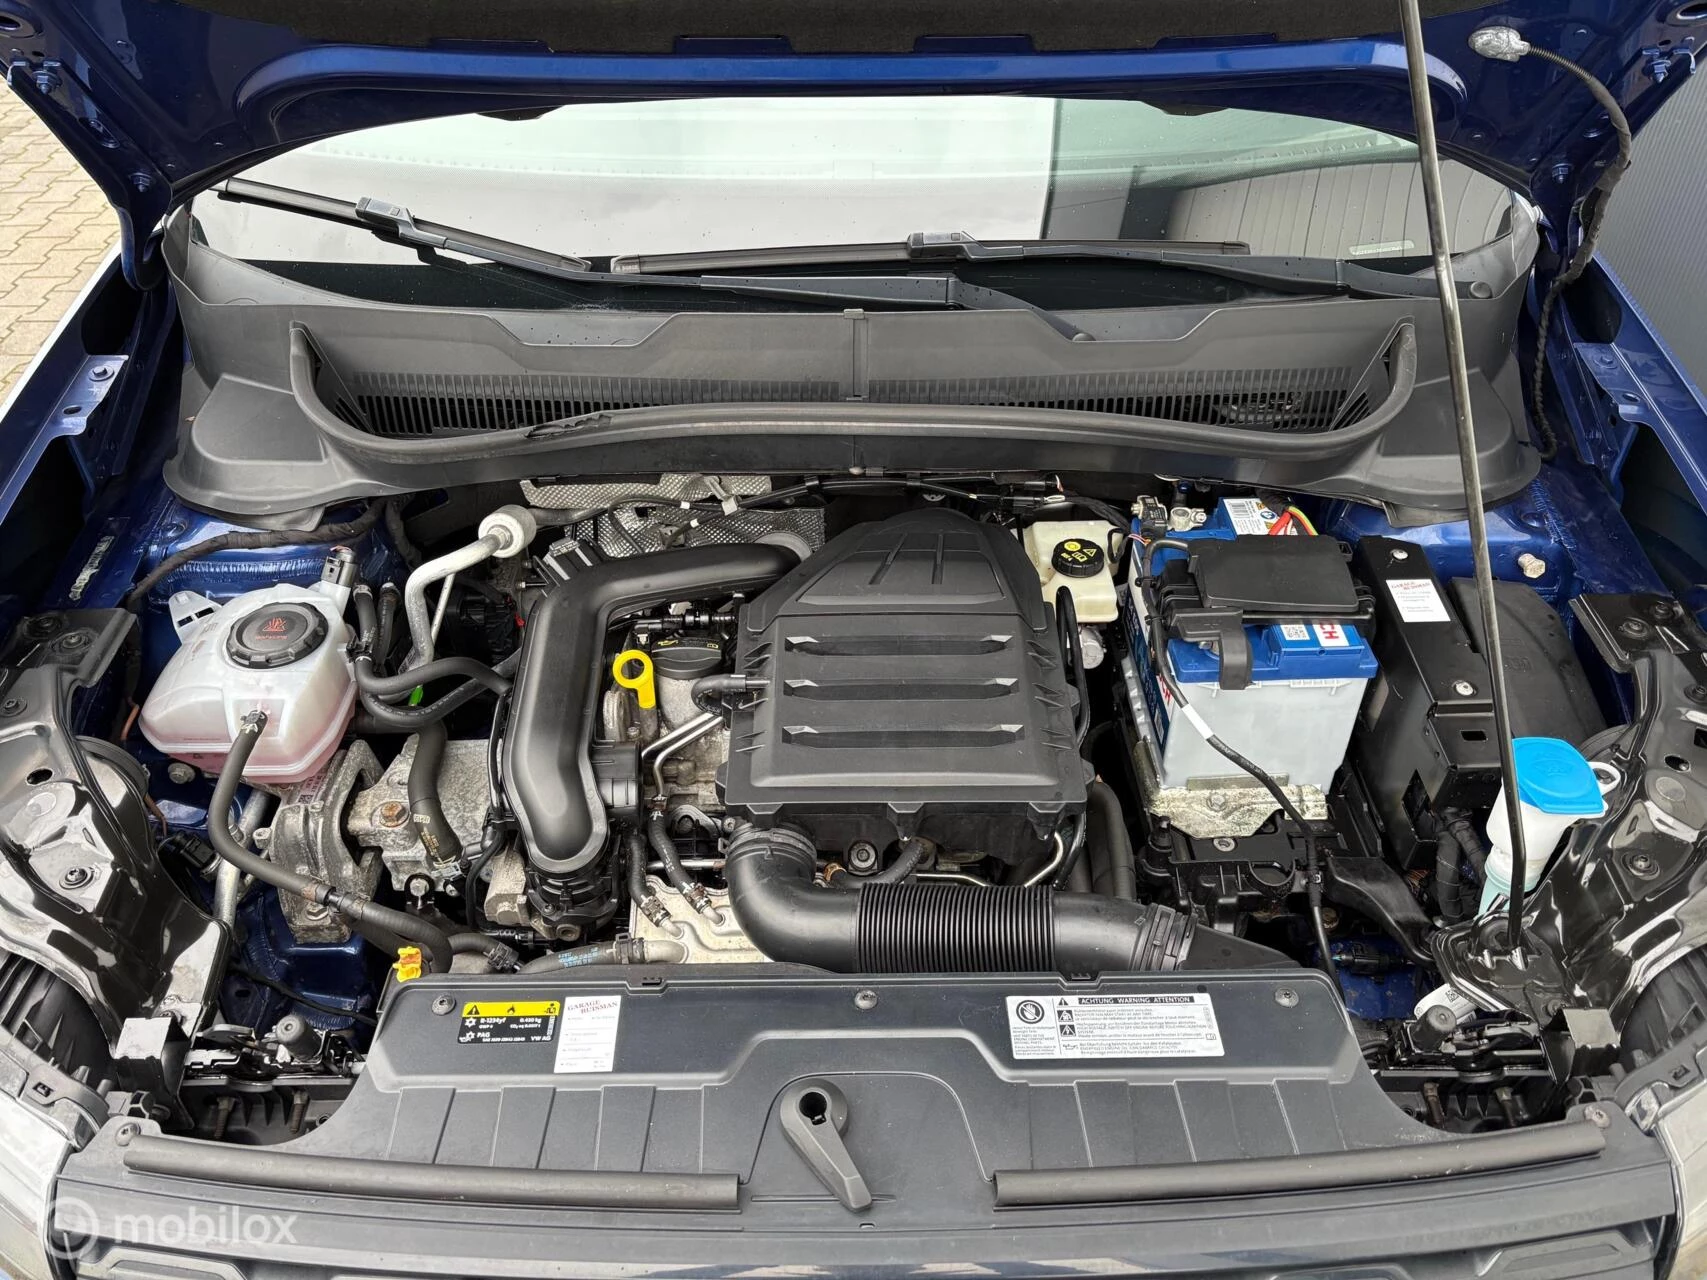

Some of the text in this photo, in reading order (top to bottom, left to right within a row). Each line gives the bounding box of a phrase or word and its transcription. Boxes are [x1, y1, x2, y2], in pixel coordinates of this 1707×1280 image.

[567, 1000, 600, 1011] GARAGE
[1081, 996, 1191, 1005] ACHTUNG WARNING ATTENTION
